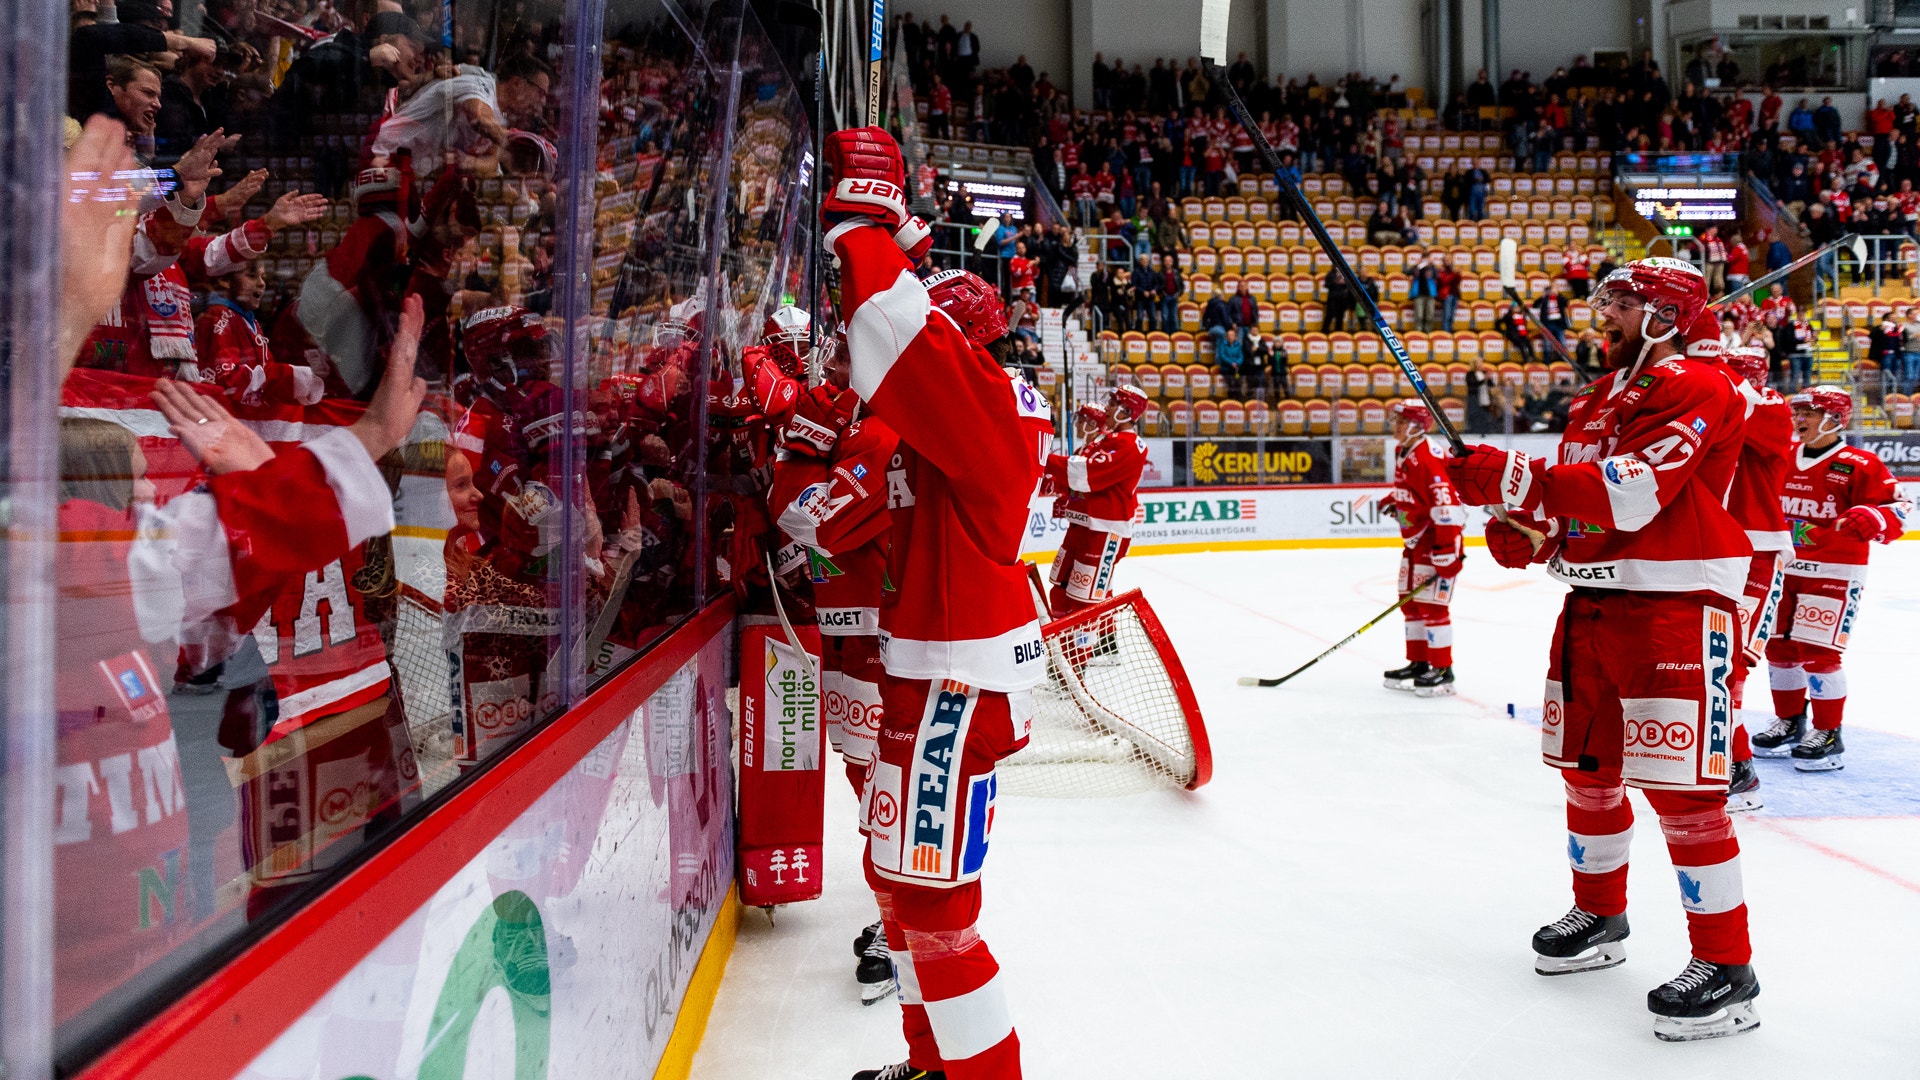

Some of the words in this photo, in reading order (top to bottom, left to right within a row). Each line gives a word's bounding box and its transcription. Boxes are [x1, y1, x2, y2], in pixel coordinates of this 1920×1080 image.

[869, 70, 879, 125] NEXUS
[1381, 326, 1423, 384] BAUER
[1692, 418, 1707, 432] ST
[1144, 499, 1240, 524] PEAB
[1097, 540, 1118, 591] PEAB
[1656, 662, 1702, 671] BAUER
[1709, 630, 1728, 758] PEAB
[744, 696, 755, 768] BAUER
[779, 669, 796, 770] norrlands
[914, 690, 967, 850] PEAB
